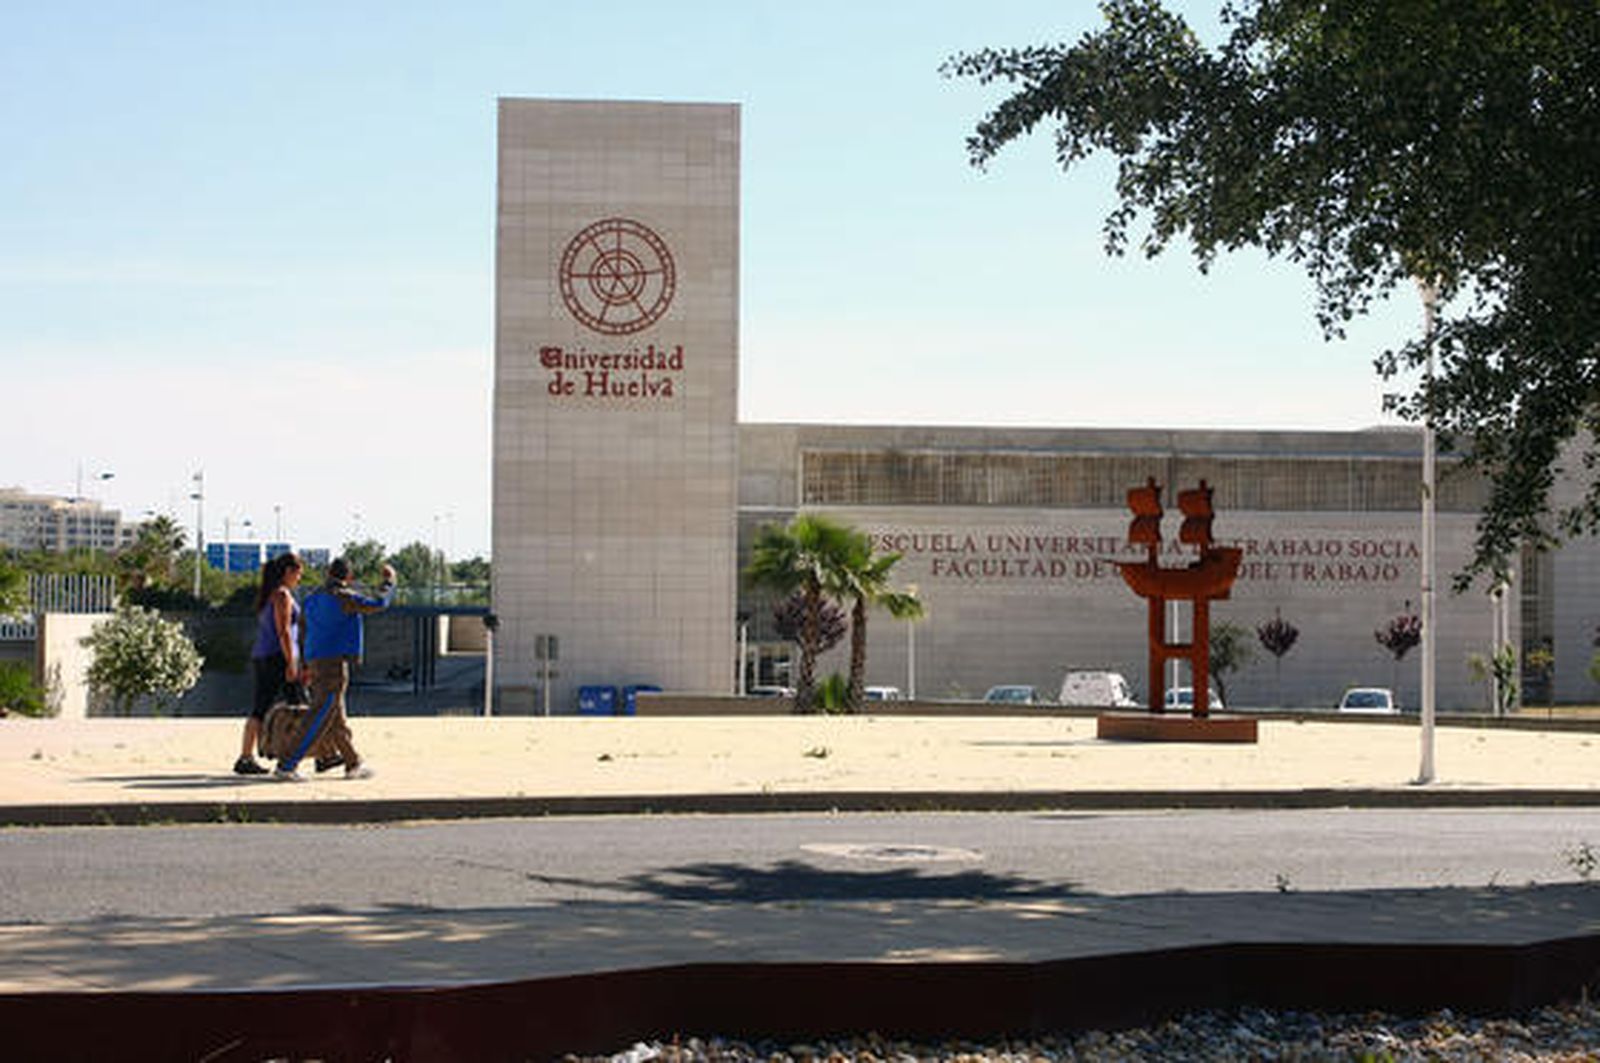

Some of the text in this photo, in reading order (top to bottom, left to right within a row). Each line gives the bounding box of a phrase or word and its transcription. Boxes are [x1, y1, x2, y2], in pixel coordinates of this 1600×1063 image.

[540, 344, 684, 370] Universidad
[548, 371, 673, 396] de Huelva
[1234, 539, 1342, 558] TRABAJO
[1348, 540, 1420, 559] SOCIA
[932, 558, 1066, 579] FACULTAD
[1075, 559, 1103, 578] DE
[1290, 562, 1400, 581] TRABAJO
